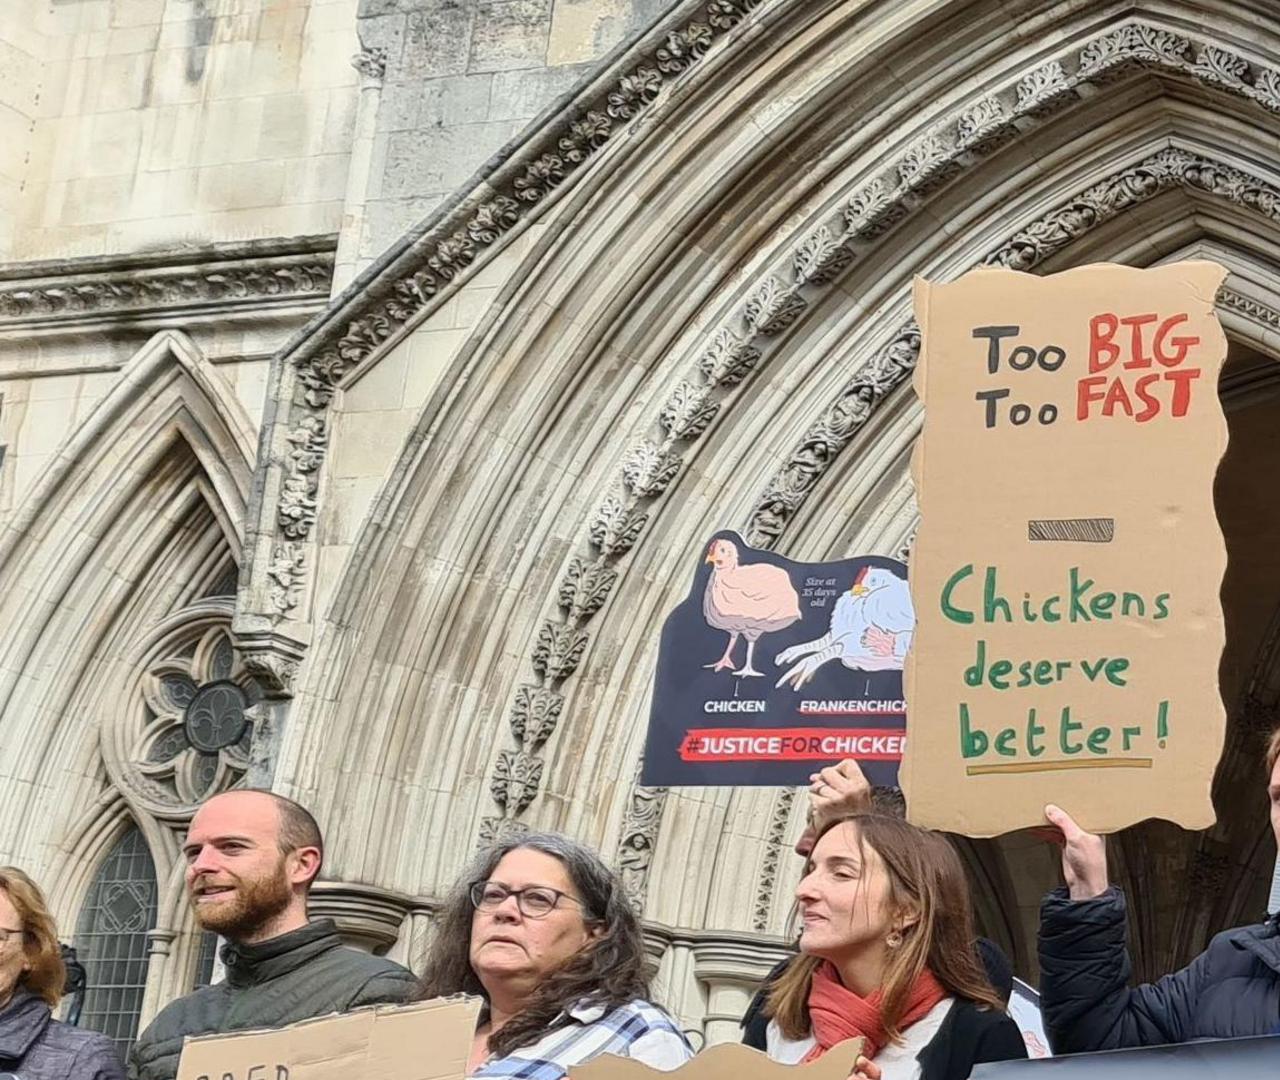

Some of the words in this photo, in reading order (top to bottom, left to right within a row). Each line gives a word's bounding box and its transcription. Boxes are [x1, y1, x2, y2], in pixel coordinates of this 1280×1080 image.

[973, 325, 1066, 374] Too
[1089, 313, 1200, 373] BIG
[976, 389, 1058, 428] Too
[1077, 368, 1201, 422] FAST
[940, 564, 1171, 625] Chickens
[963, 640, 1130, 689] deserve
[704, 700, 765, 712] CHICKEN
[959, 701, 1169, 759] better!
